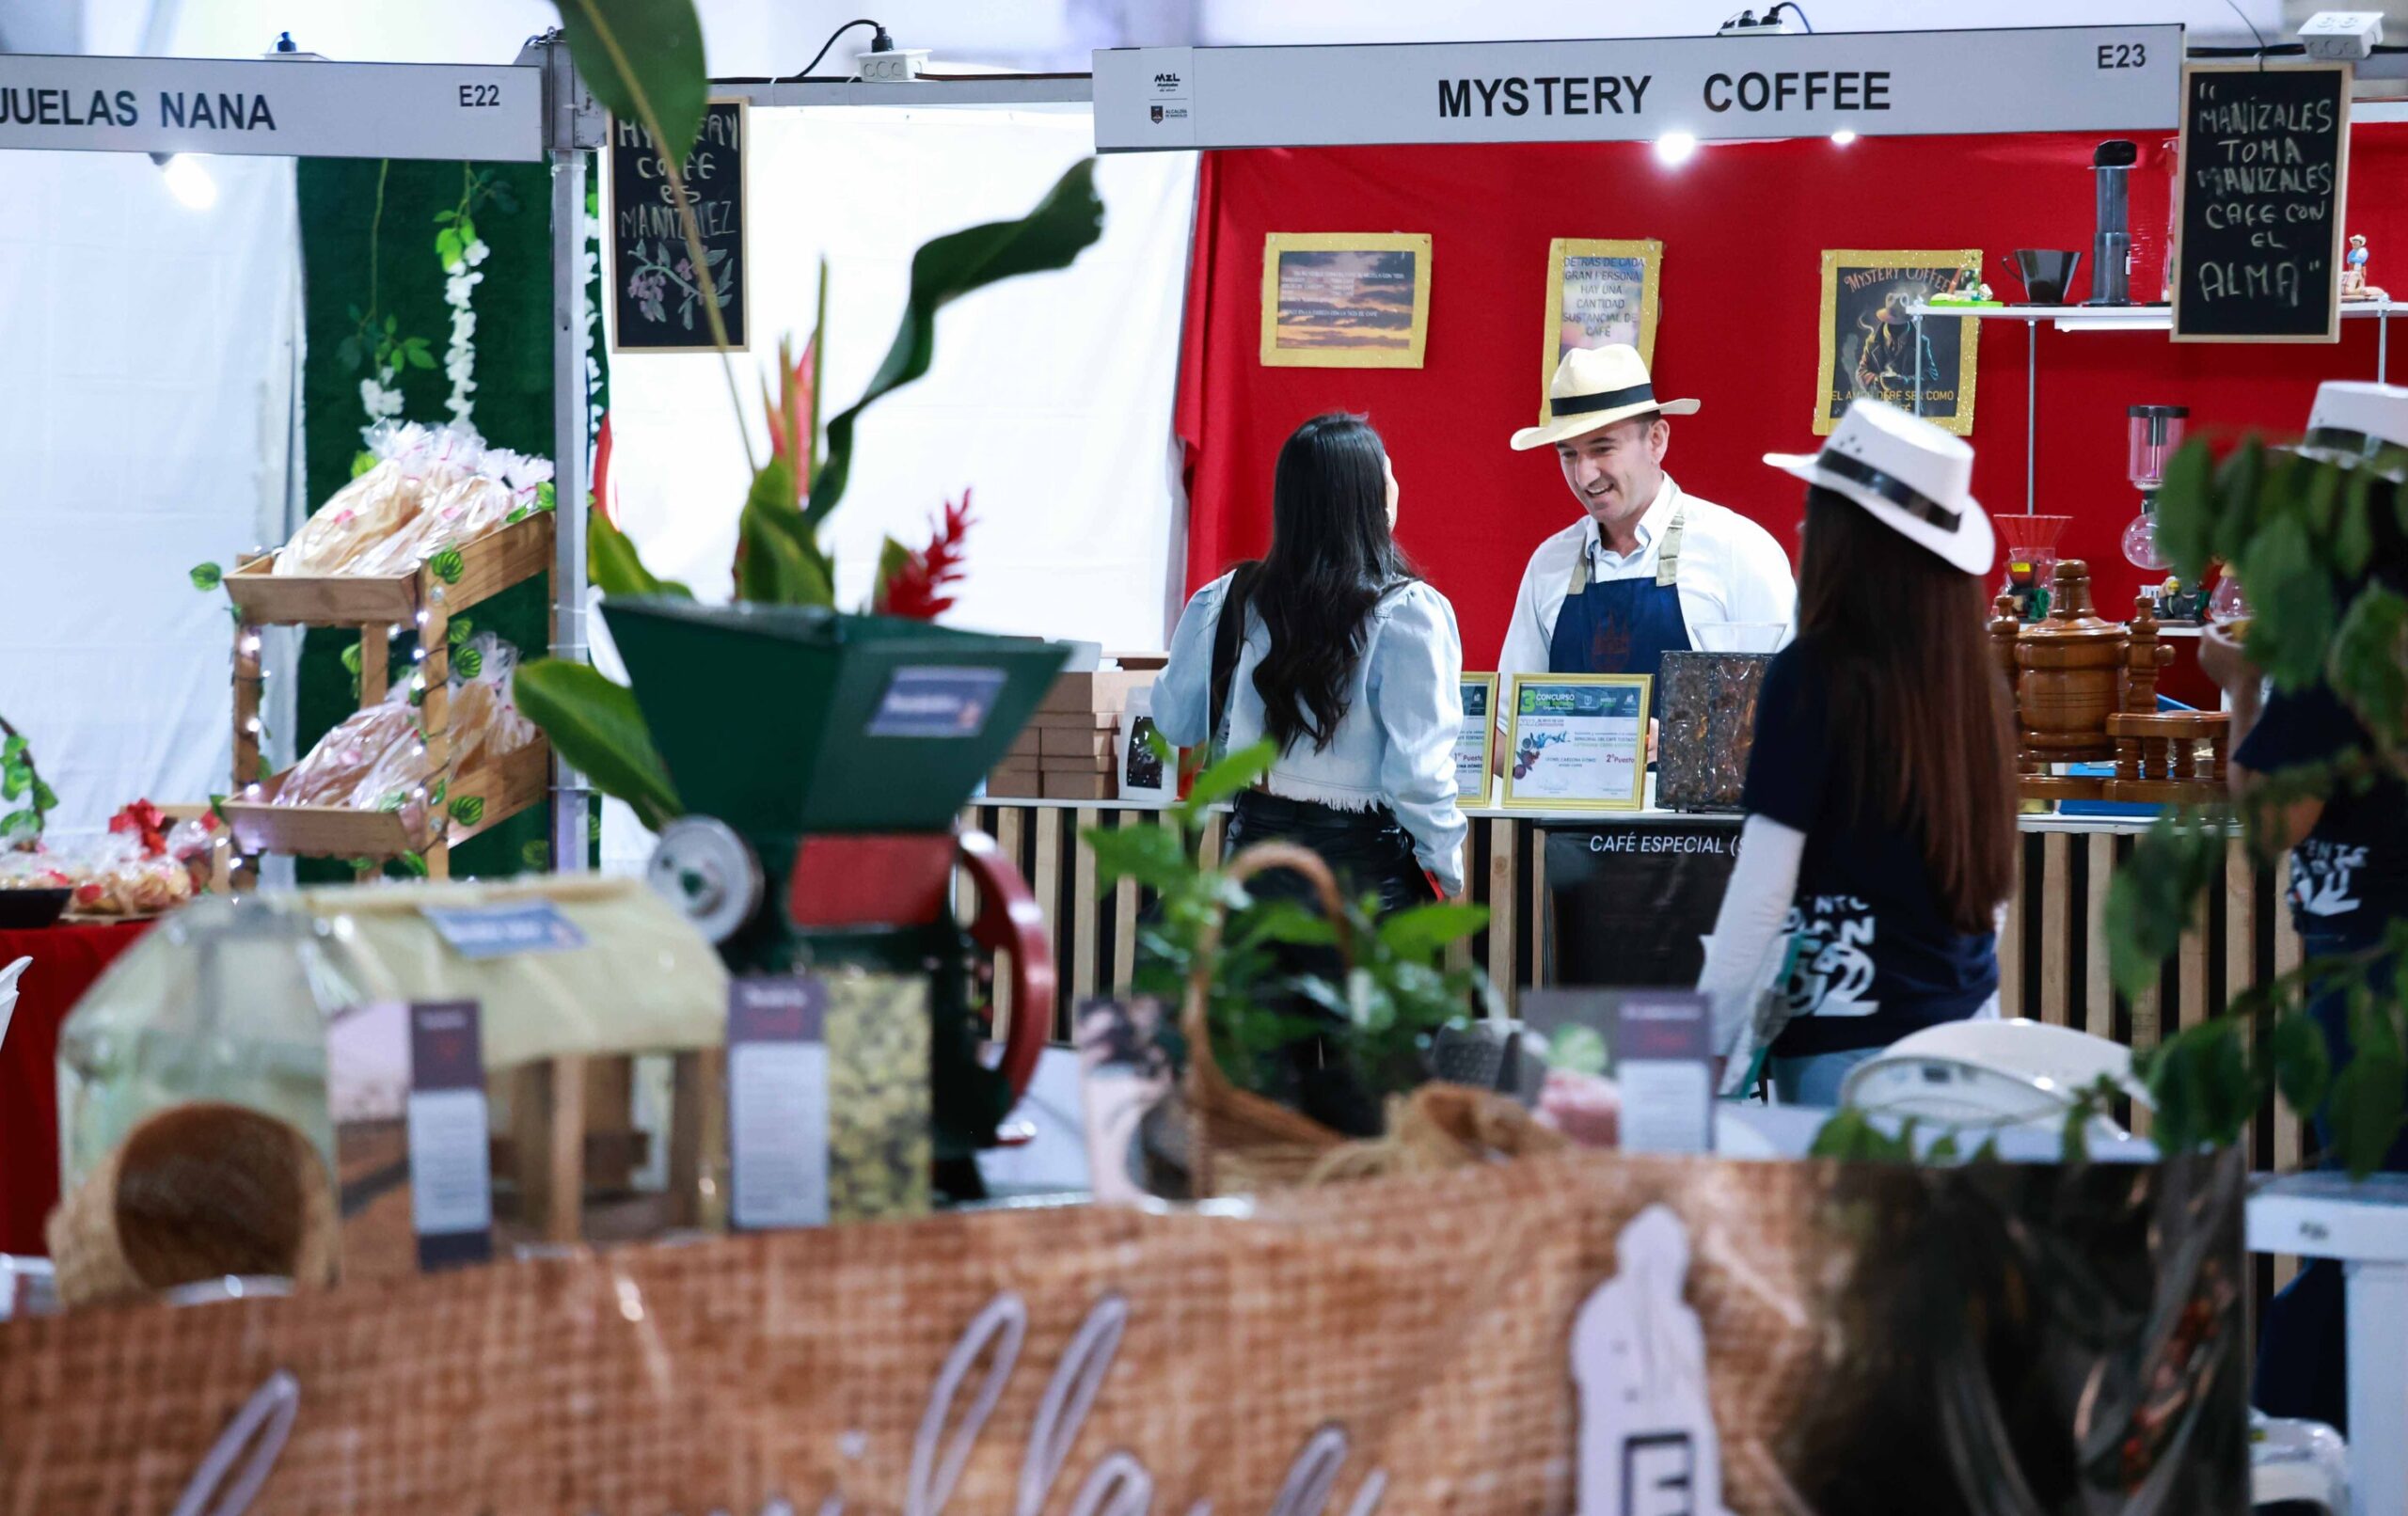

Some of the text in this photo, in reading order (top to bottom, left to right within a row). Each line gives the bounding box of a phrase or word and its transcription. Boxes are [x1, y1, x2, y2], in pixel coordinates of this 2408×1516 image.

[2098, 43, 2147, 69] E23
[459, 85, 500, 107] E22
[1438, 71, 1892, 118] MYSTERY COFFEE
[160, 91, 277, 131] NANA
[2217, 137, 2303, 165] TOMA
[2251, 231, 2288, 248] EL
[1565, 271, 1592, 280] GRAN
[1580, 285, 1623, 294] HAY UNA
[1925, 390, 1954, 401] COMO
[1520, 689, 1536, 713] 3
[1590, 831, 1637, 853] CAFÉ
[1640, 836, 1724, 854] ESPECIAL
